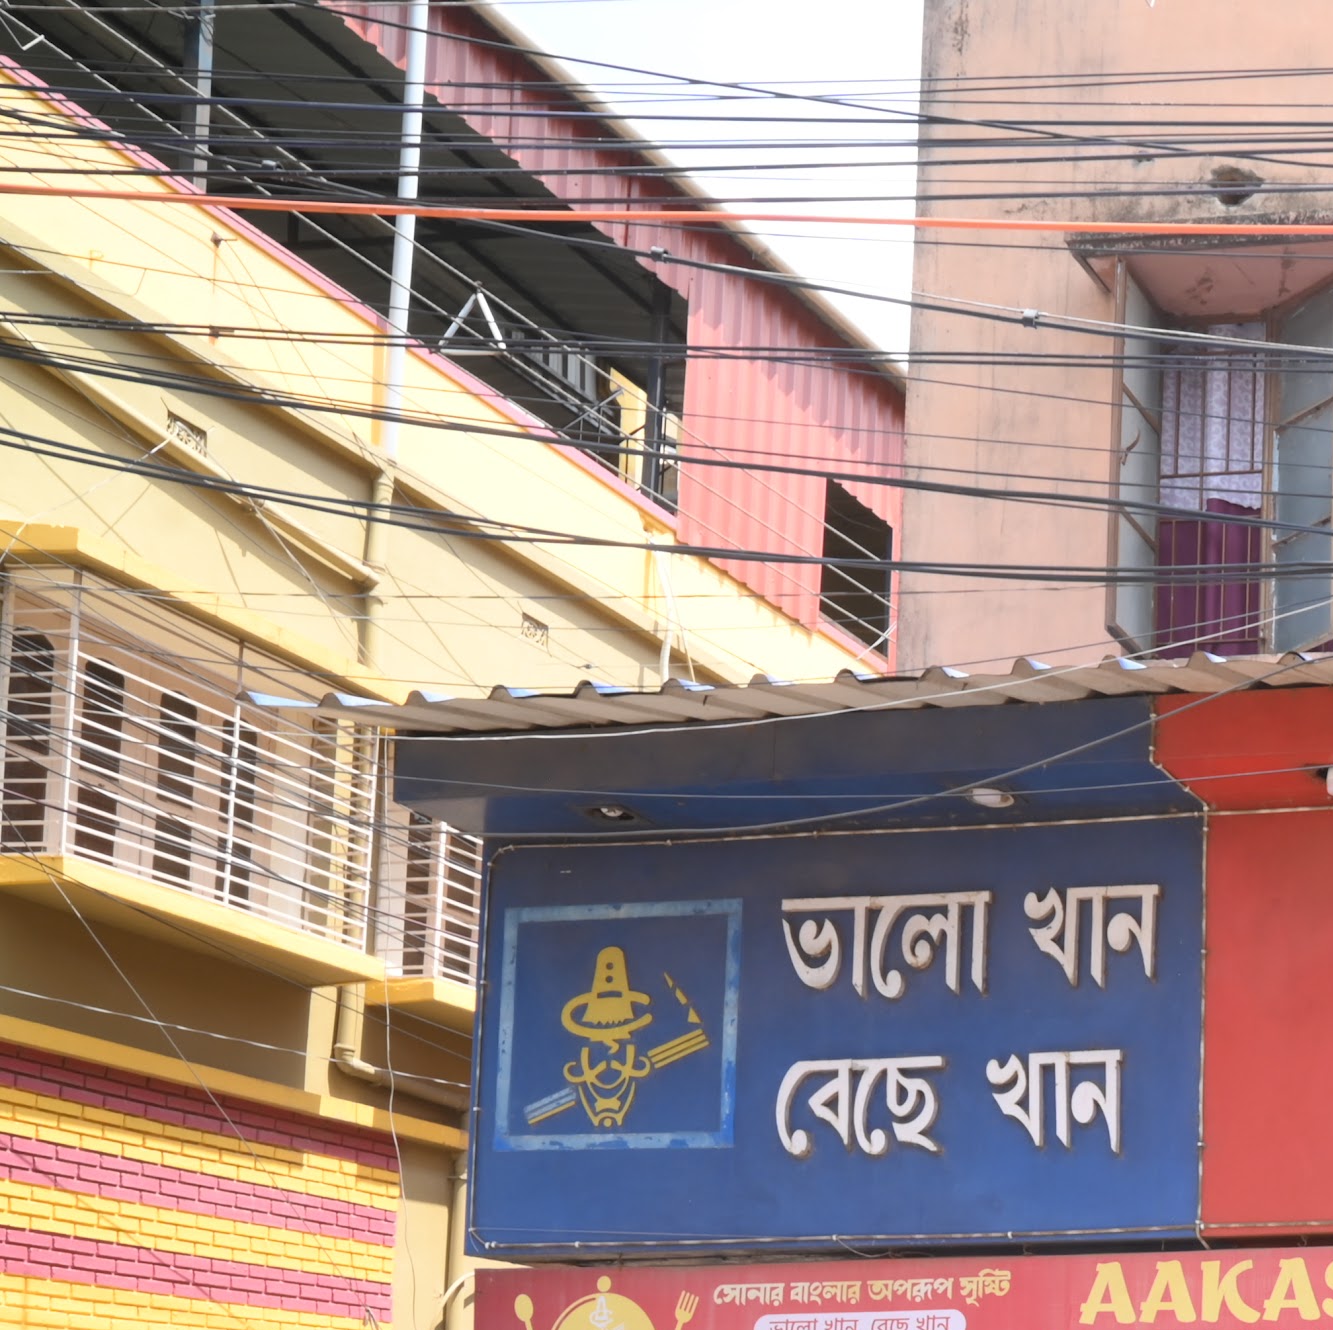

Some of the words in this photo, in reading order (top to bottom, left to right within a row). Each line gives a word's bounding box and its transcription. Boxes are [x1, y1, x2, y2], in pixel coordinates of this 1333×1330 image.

[781, 891, 994, 998] ভালো
[1024, 884, 1162, 988] খান
[776, 1056, 946, 1157] বেছে
[986, 1049, 1123, 1154] খান
[713, 1280, 782, 1307] সোনার
[789, 1280, 860, 1306] বাংলার
[867, 1276, 954, 1304] অপরূপ
[959, 1268, 1012, 1309] সৃষ্টি
